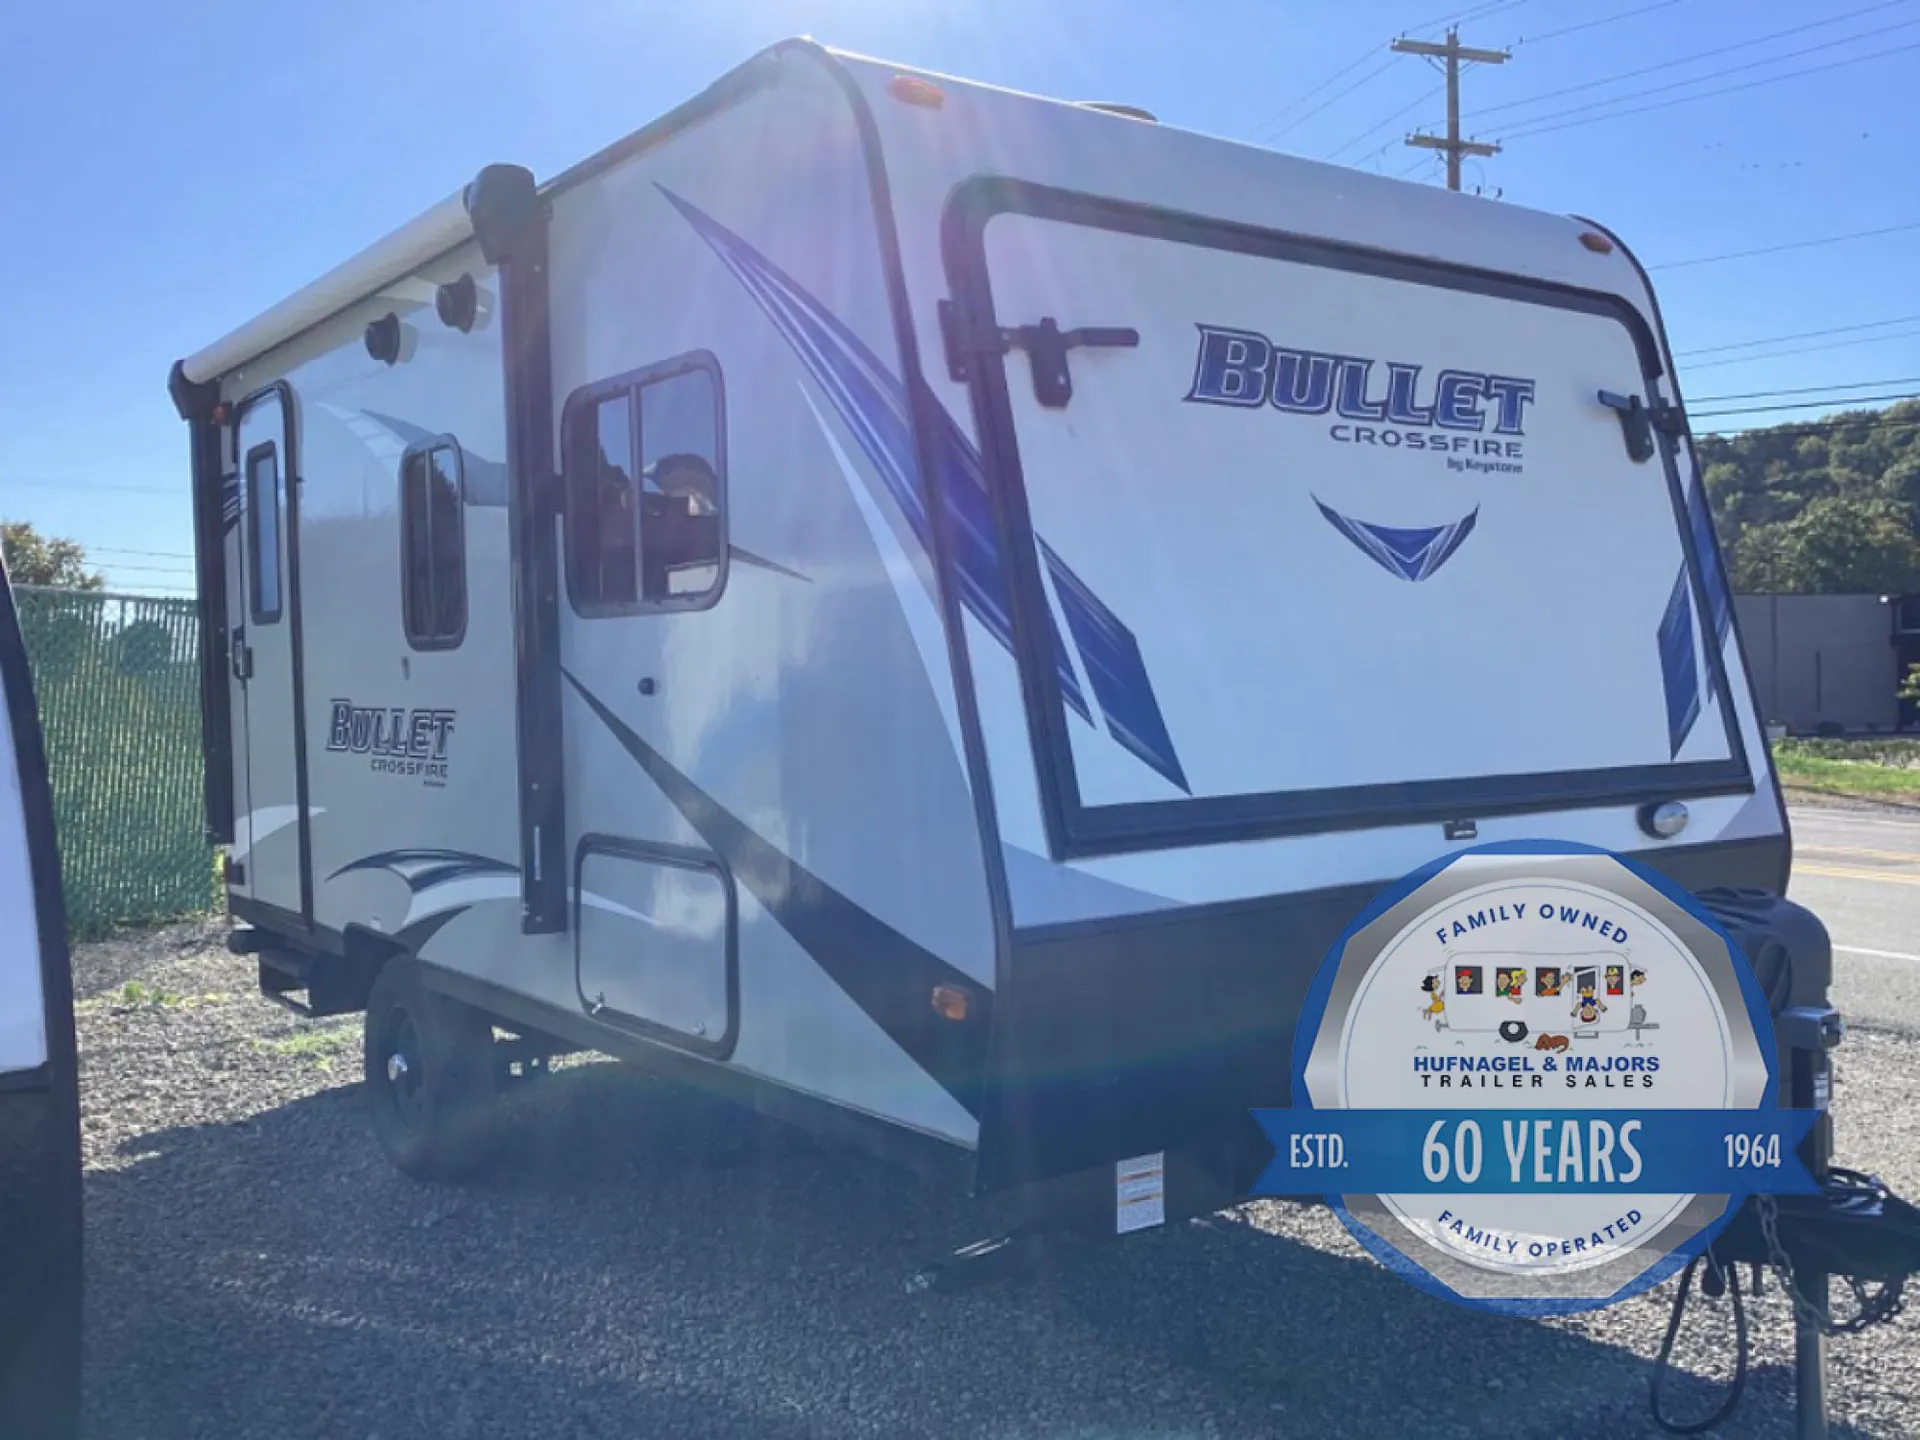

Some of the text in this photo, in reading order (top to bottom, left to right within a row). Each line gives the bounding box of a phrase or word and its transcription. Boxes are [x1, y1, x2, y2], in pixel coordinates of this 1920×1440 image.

[1181, 322, 1536, 436] BULLET
[1330, 424, 1523, 458] CROSSFIRE
[326, 698, 456, 760] BULLET
[370, 759, 449, 778] CROSSFIRE
